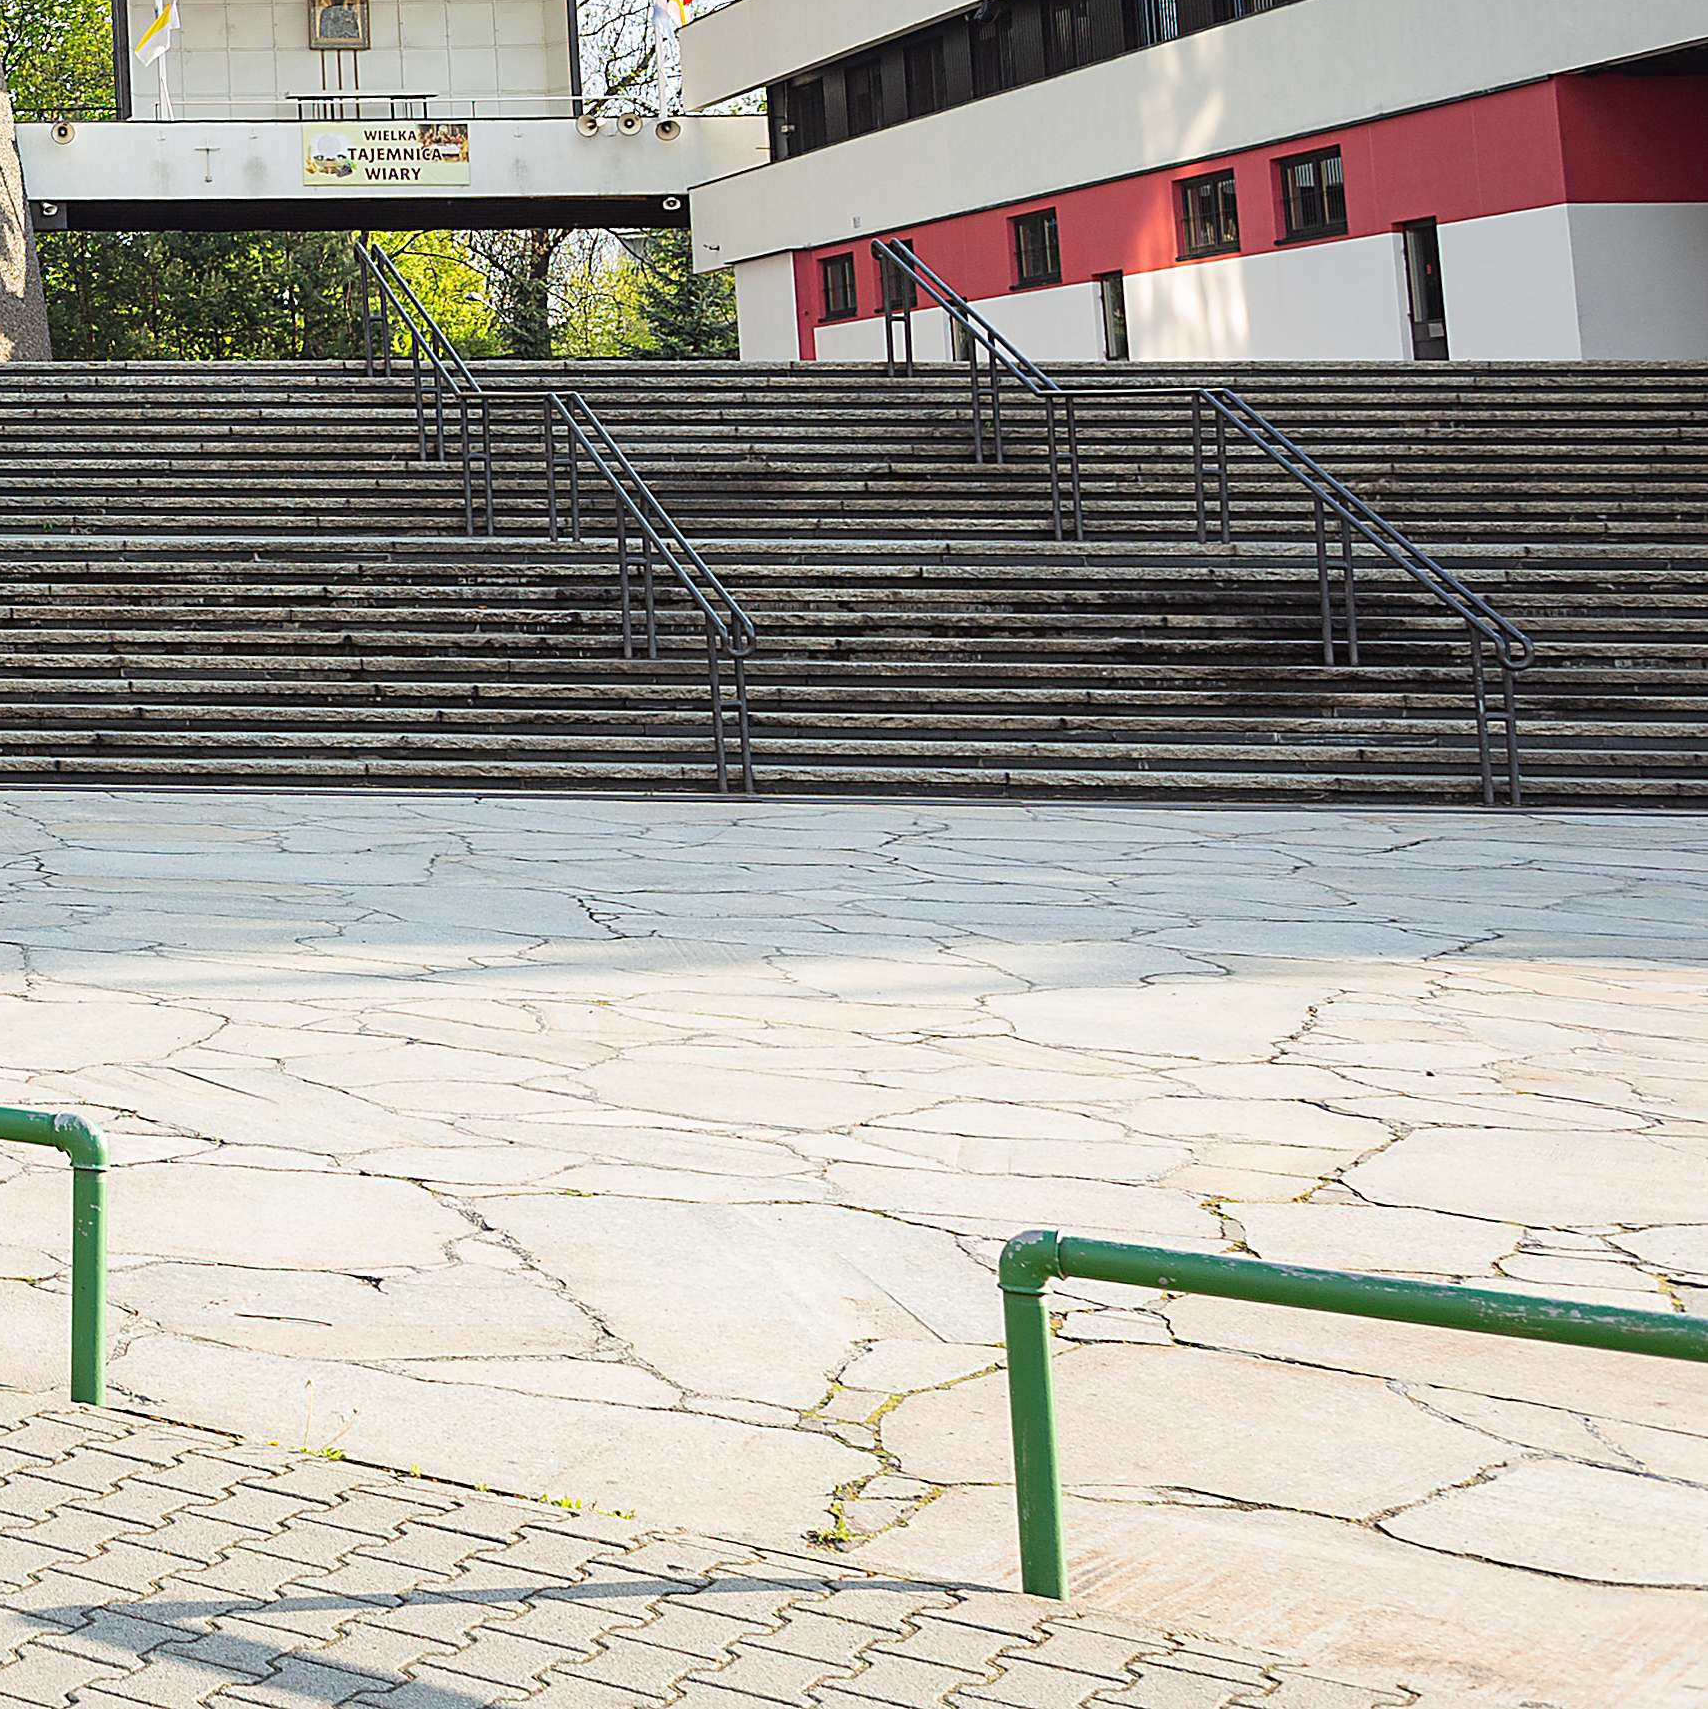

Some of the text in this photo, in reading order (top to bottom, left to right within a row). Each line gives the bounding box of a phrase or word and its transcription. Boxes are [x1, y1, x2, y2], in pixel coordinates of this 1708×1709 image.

[364, 130, 416, 141] WIELKA
[347, 148, 442, 163] TAJEMNICA
[365, 168, 421, 180] WIARY
